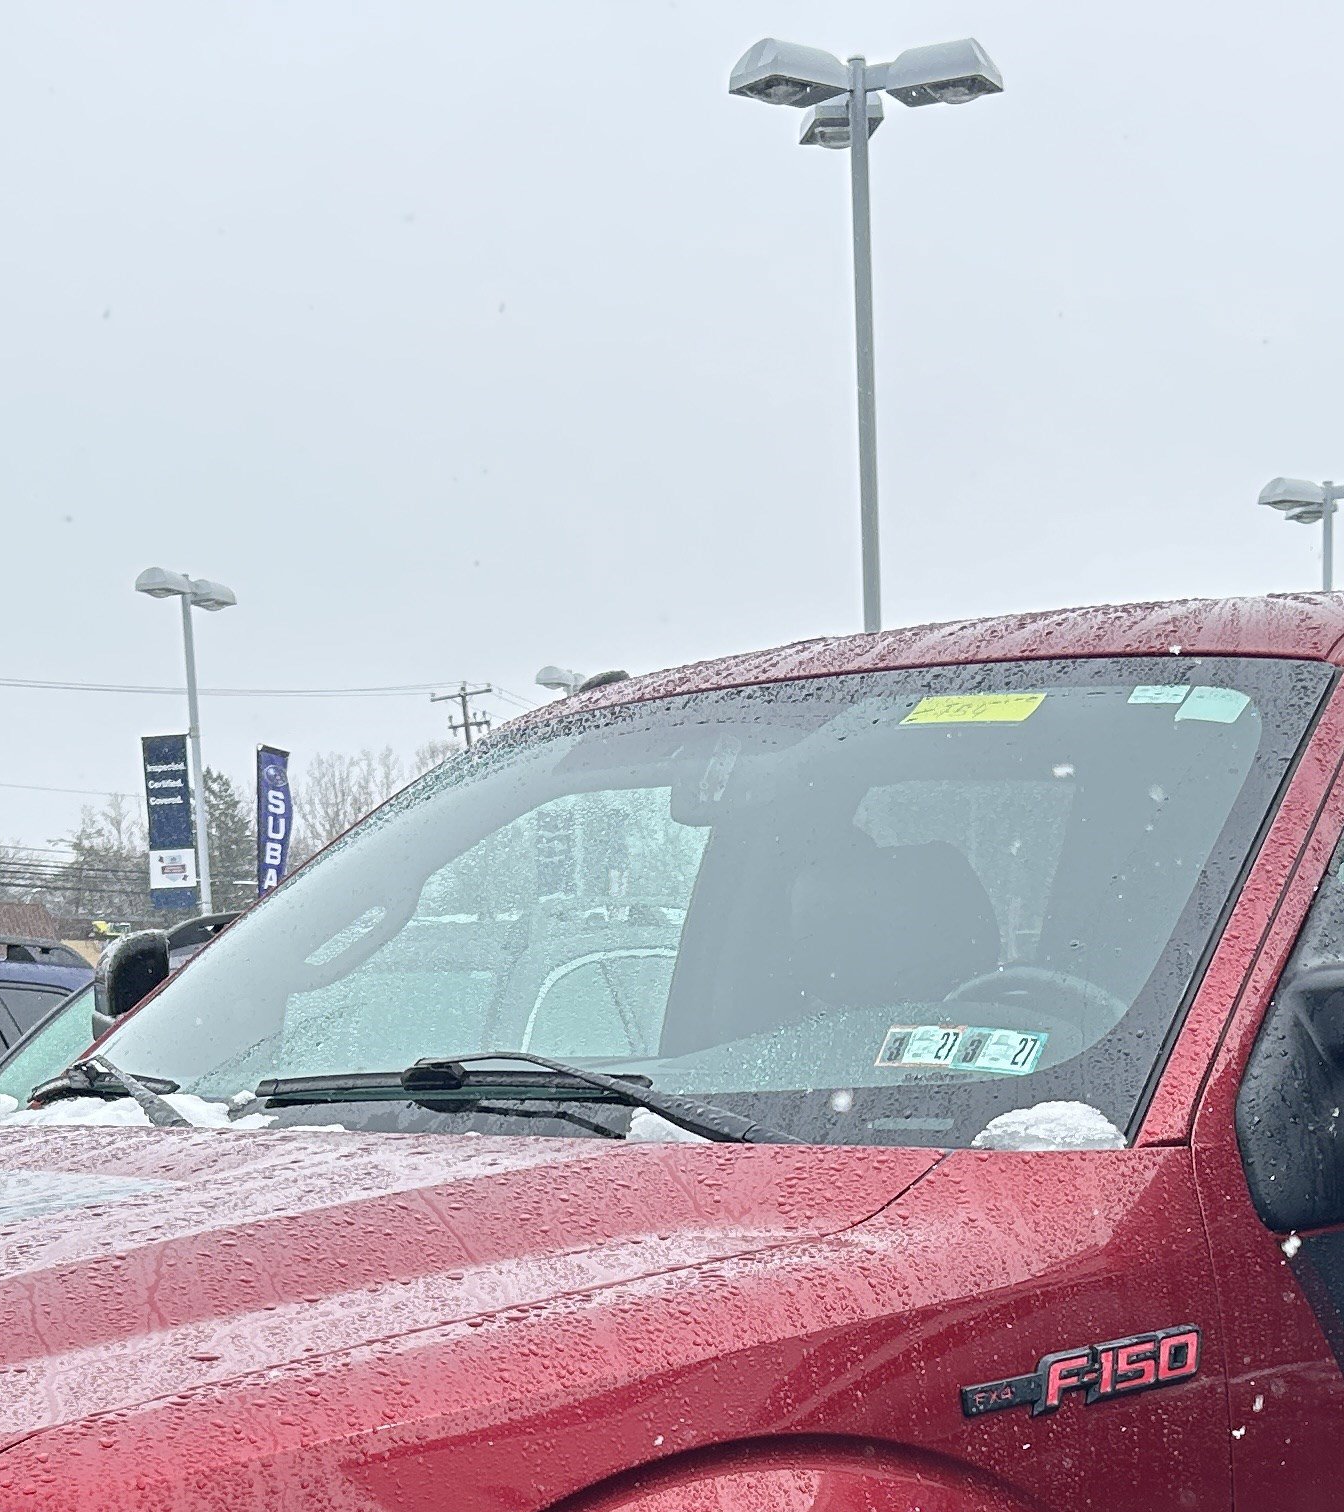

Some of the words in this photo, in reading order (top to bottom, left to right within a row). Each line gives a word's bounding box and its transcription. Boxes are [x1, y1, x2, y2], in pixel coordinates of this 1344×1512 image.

[933, 1031, 960, 1062] 27
[1010, 1037, 1039, 1069] 27
[1041, 1326, 1202, 1411] F-150
[973, 1385, 1014, 1407] FX4
